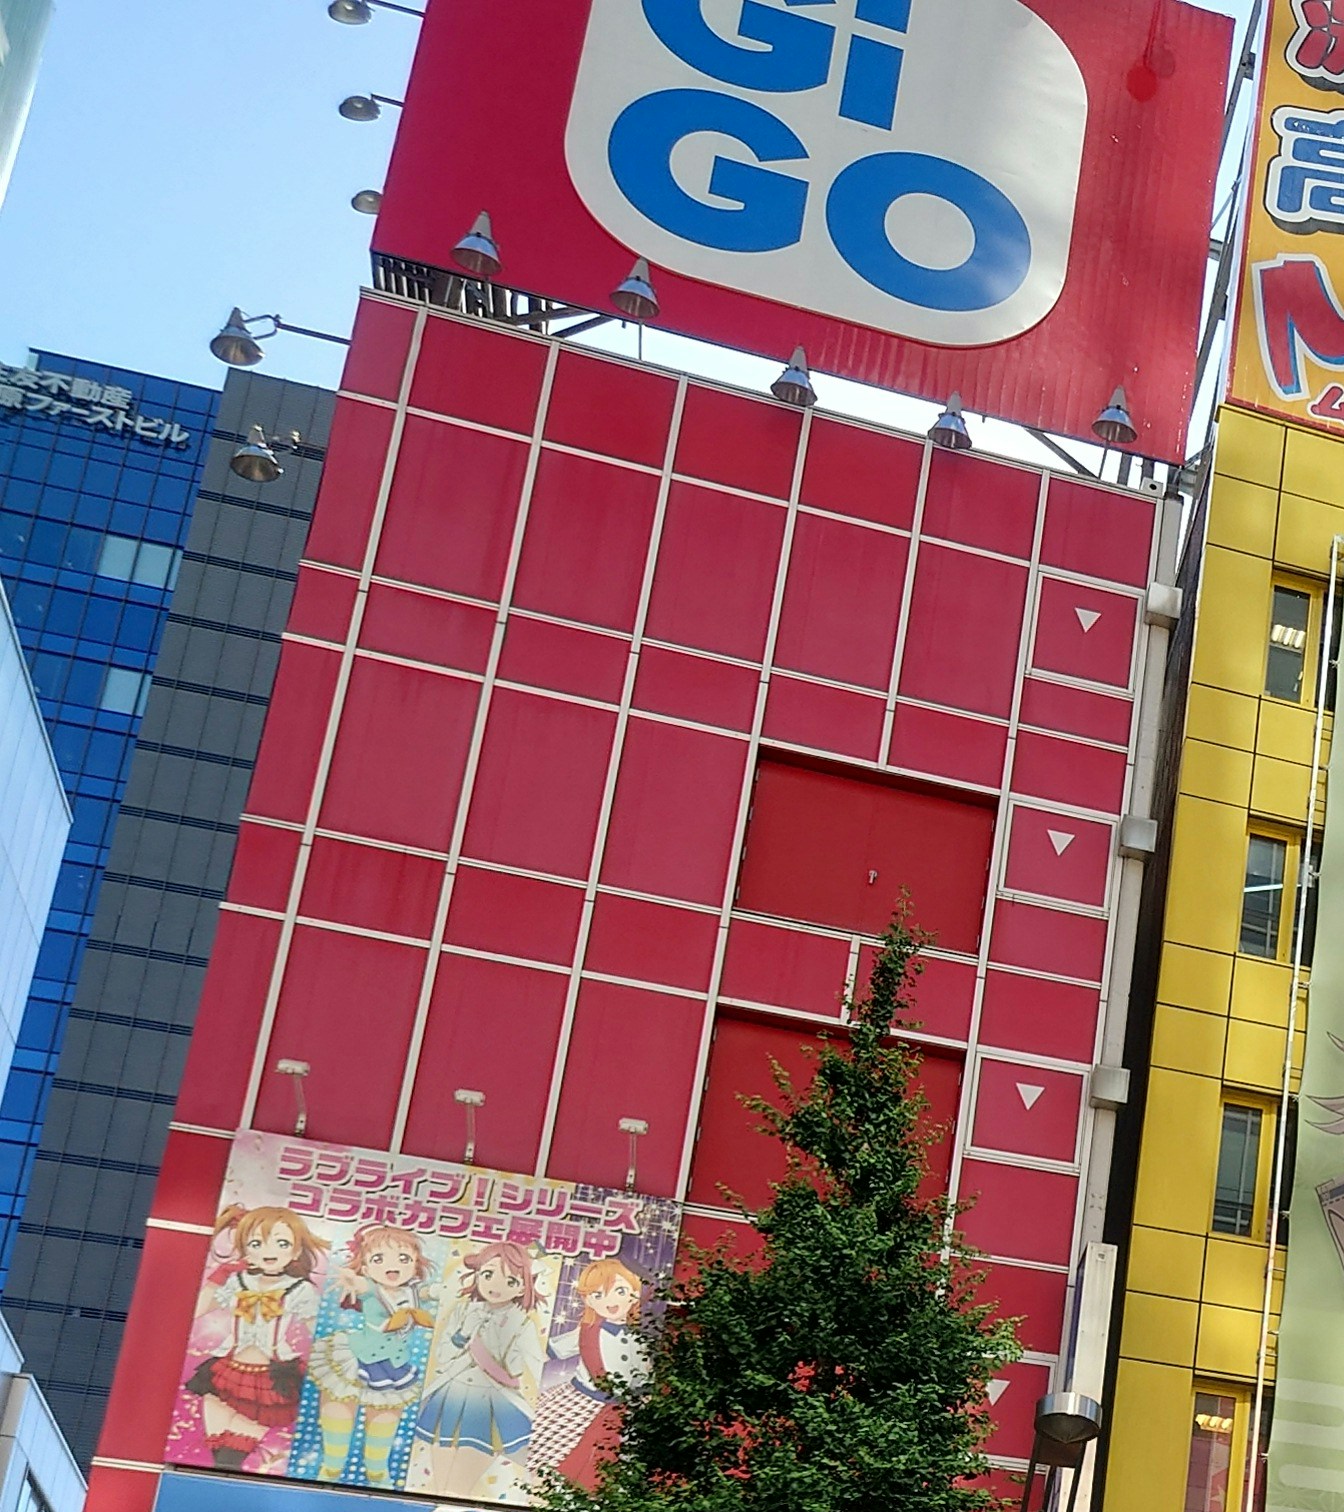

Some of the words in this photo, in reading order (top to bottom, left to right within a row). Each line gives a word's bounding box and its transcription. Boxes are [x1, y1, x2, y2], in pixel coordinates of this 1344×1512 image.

[607, 87, 1031, 312] GO
[287, 1183, 622, 1260] コラボカフェ展開中
